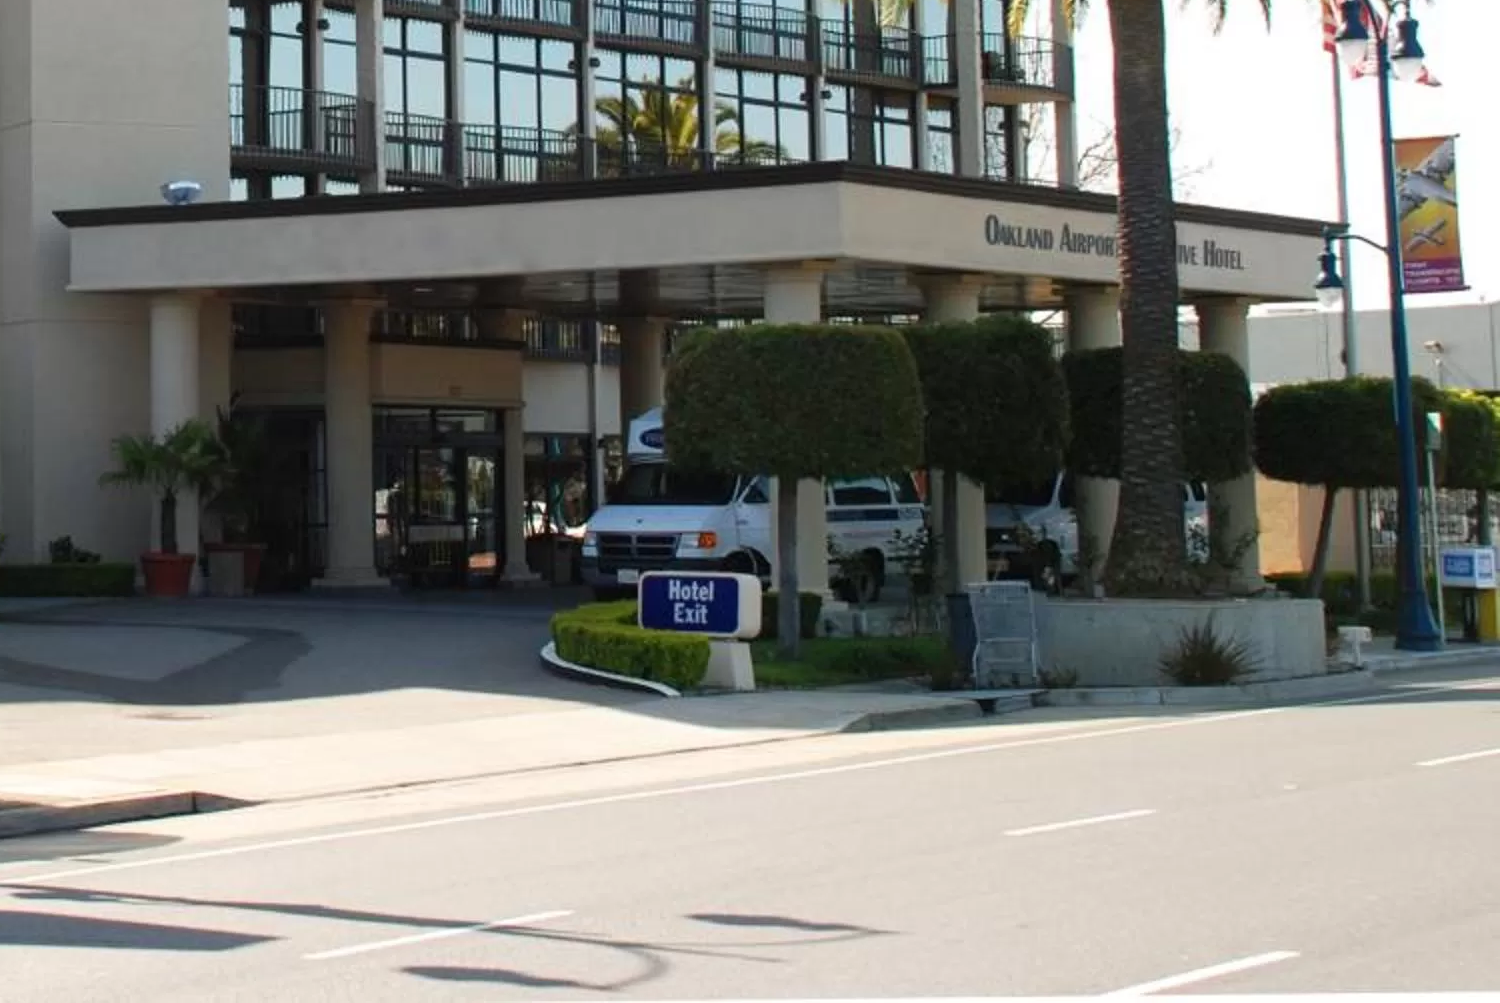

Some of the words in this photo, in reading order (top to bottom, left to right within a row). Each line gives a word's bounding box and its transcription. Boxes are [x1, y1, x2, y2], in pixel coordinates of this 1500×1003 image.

[985, 213, 1054, 250] OAKLAND
[1060, 221, 1118, 257] AIRPOR
[1203, 239, 1246, 271] HOTEL
[668, 578, 715, 602] Hotel
[673, 602, 709, 625] Exit
